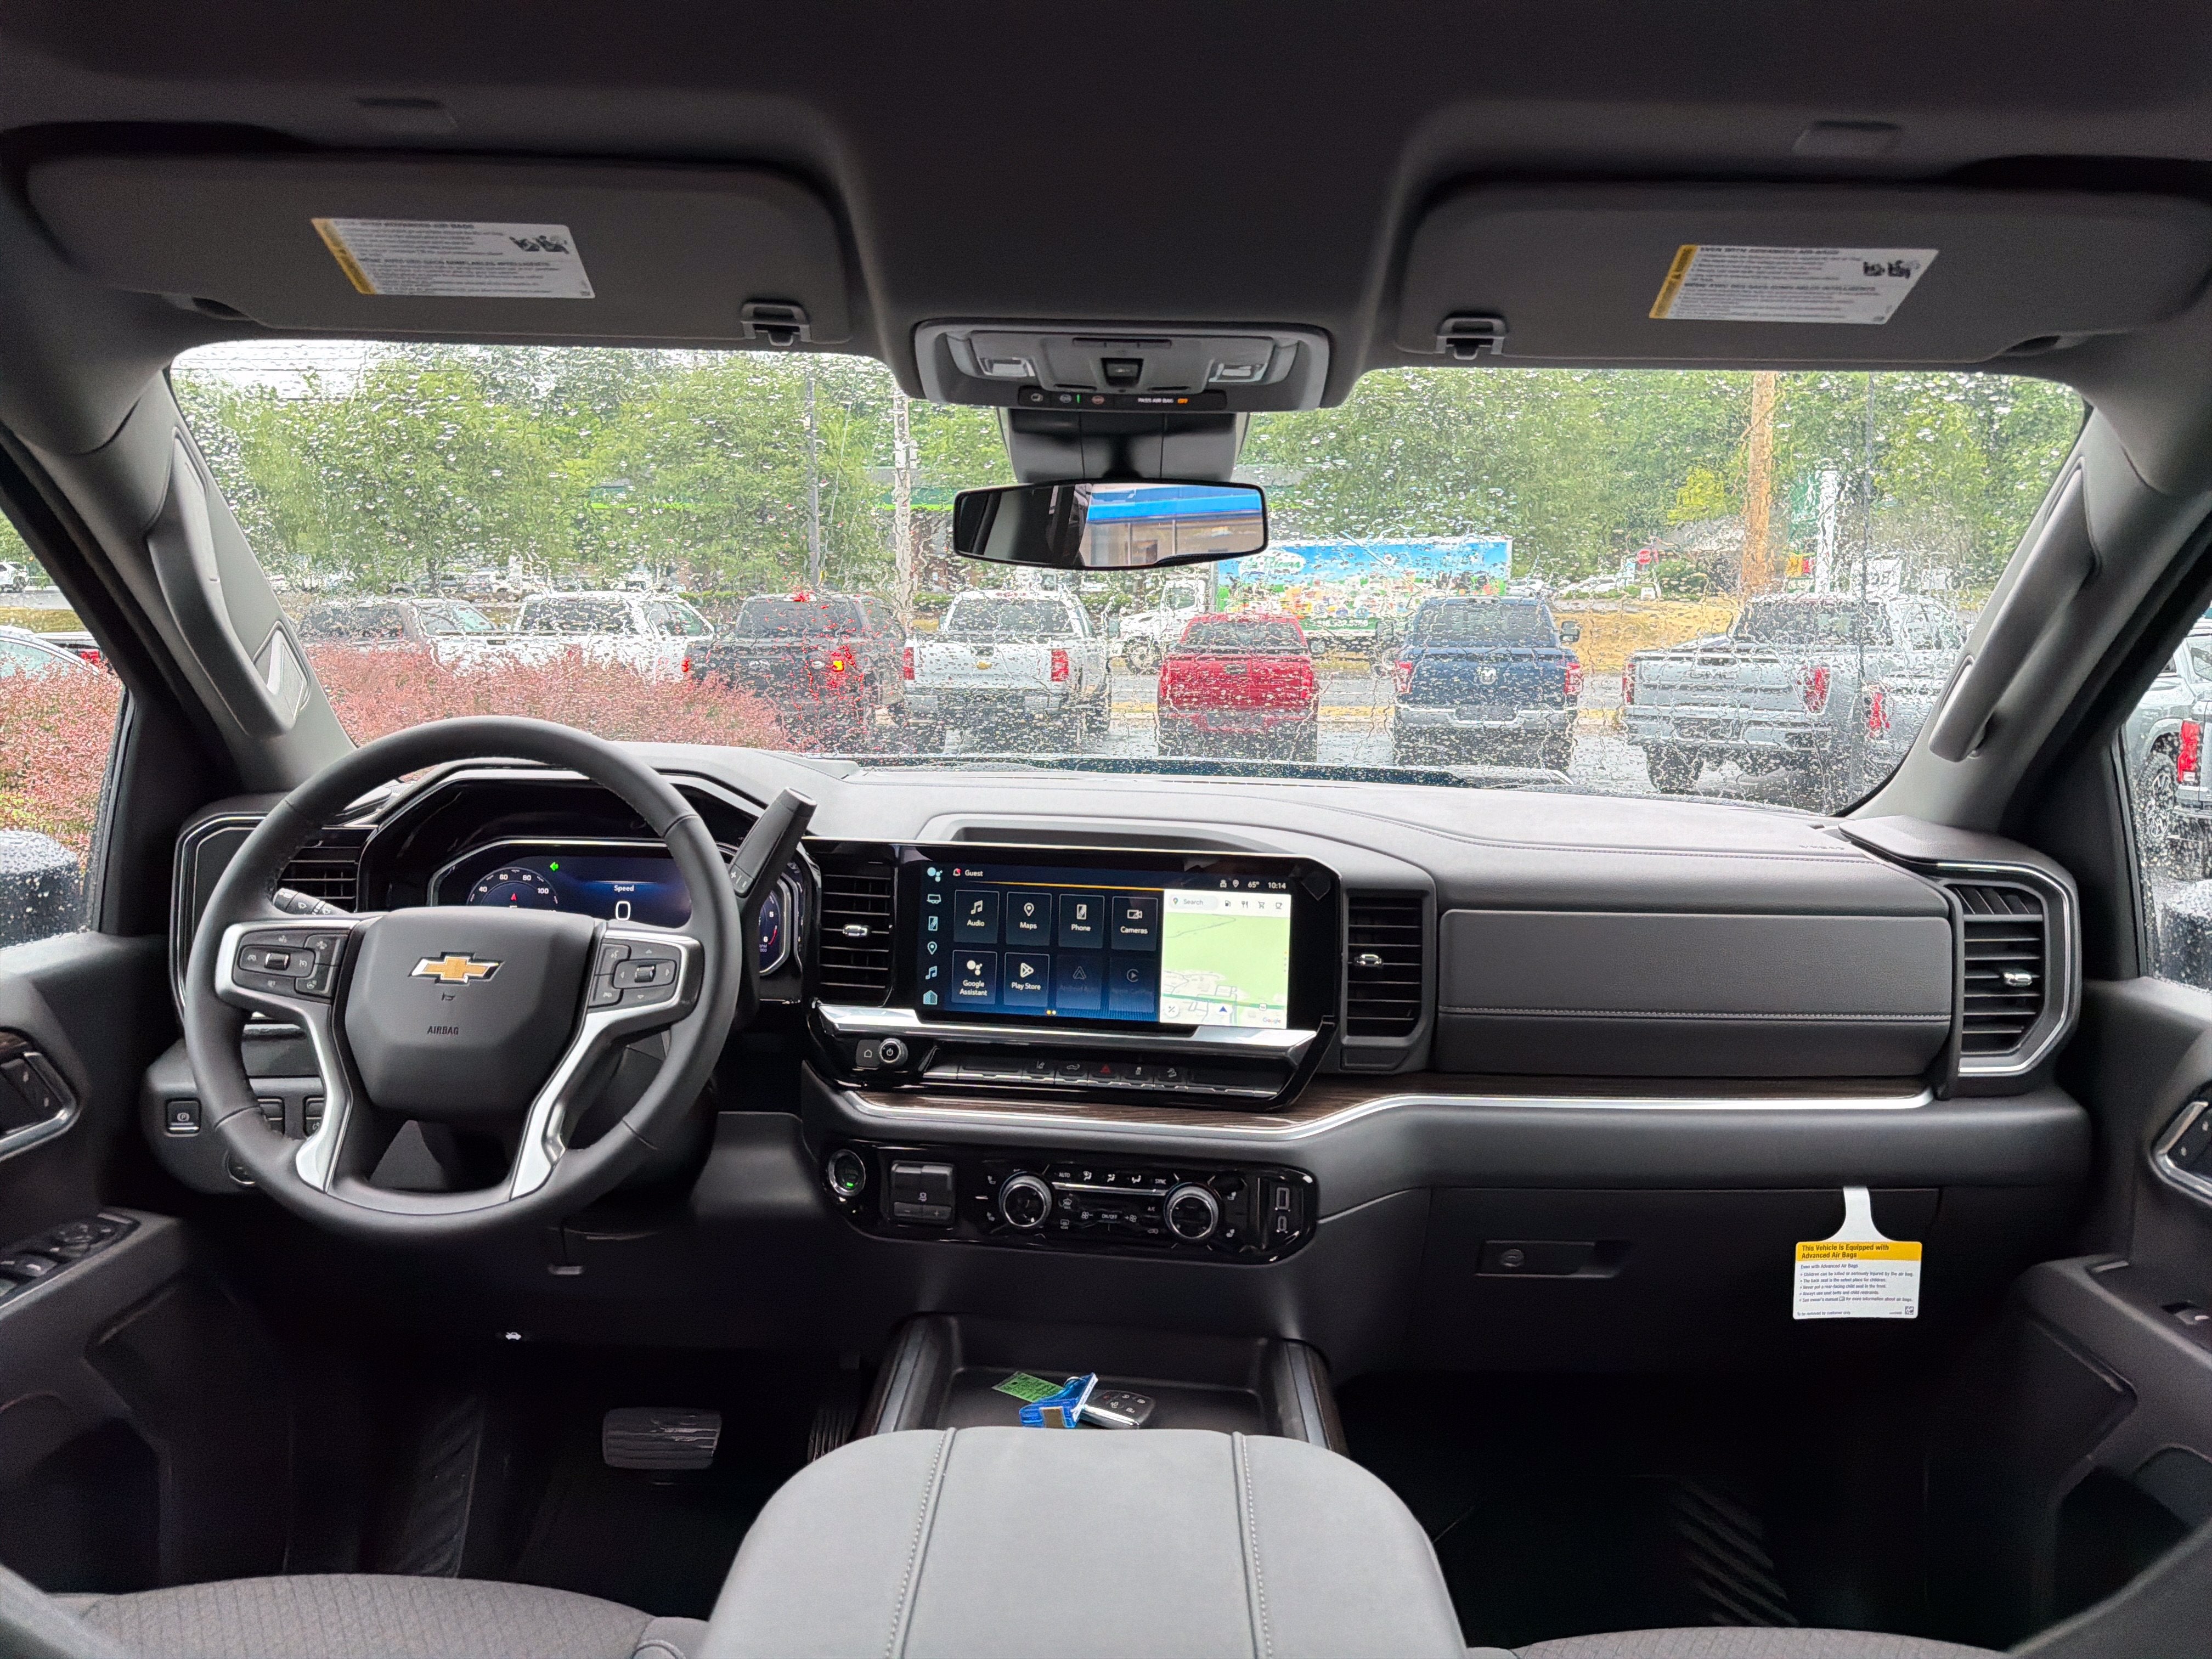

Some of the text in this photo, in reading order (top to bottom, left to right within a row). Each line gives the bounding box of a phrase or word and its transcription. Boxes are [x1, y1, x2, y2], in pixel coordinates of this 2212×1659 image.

[615, 901, 631, 921] 0
[1019, 921, 1037, 930] Maps
[1071, 923, 1091, 932] Phone
[1120, 926, 1148, 934] Cameras
[962, 979, 985, 989] Google
[1011, 981, 1024, 991] Play
[959, 988, 988, 996] Assistant
[427, 1026, 459, 1035] AIRBAG
